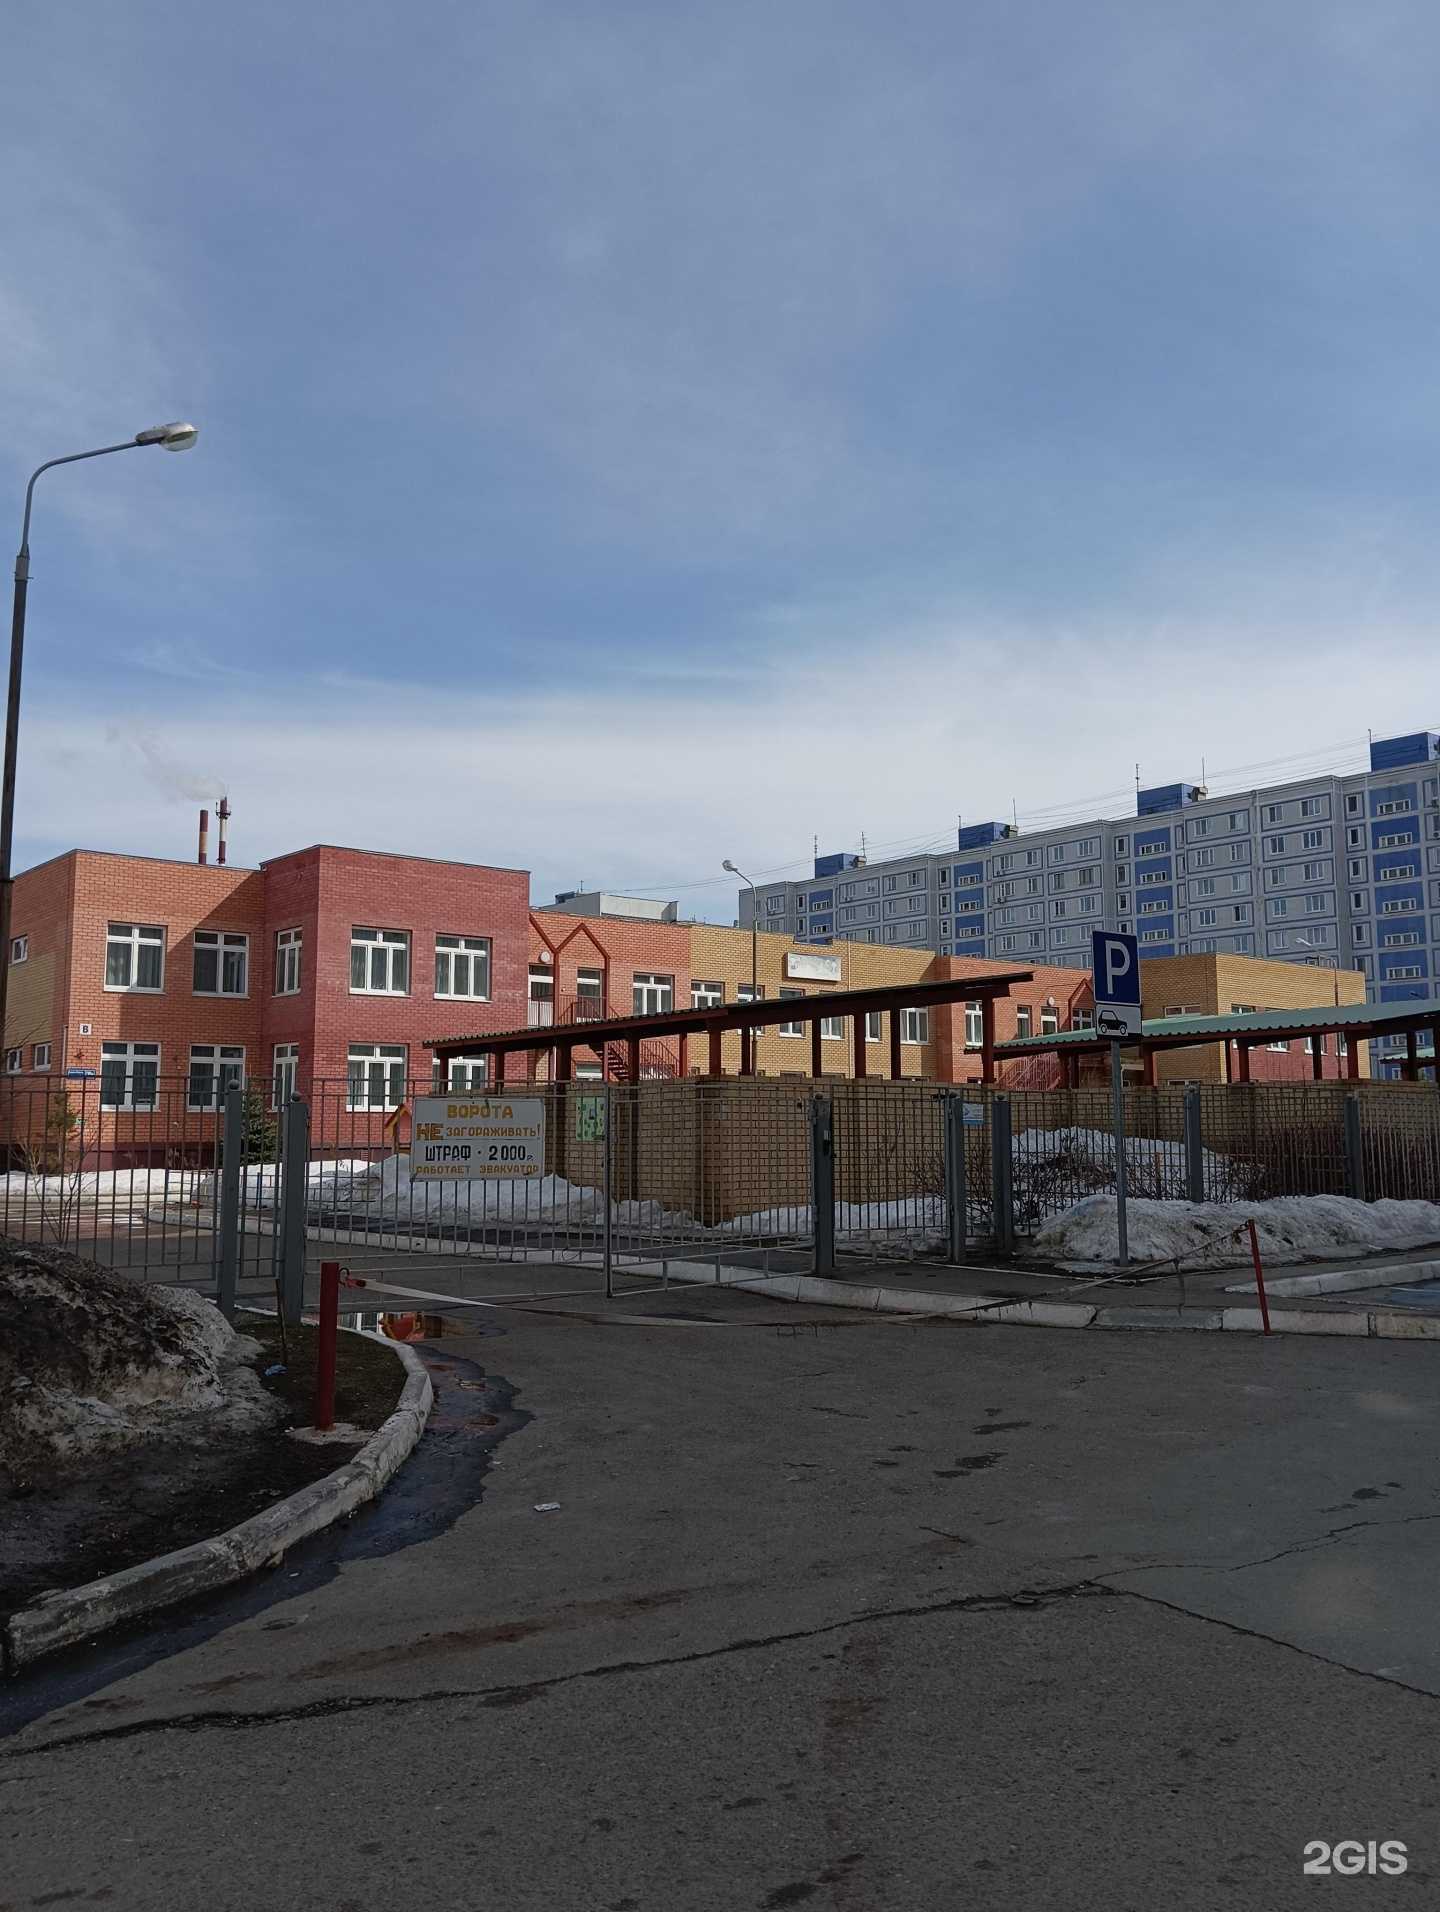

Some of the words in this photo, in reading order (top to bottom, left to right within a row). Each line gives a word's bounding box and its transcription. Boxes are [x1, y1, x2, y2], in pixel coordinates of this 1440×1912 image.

[1105, 940, 1130, 994] P
[447, 1104, 513, 1118] ВОРОТА
[416, 1122, 443, 1140] НЕ
[425, 1145, 471, 1161] ШТРАФ
[415, 1165, 471, 1175] РАБОТАЕТ
[479, 1164, 539, 1175] ЭВАКУАТОР
